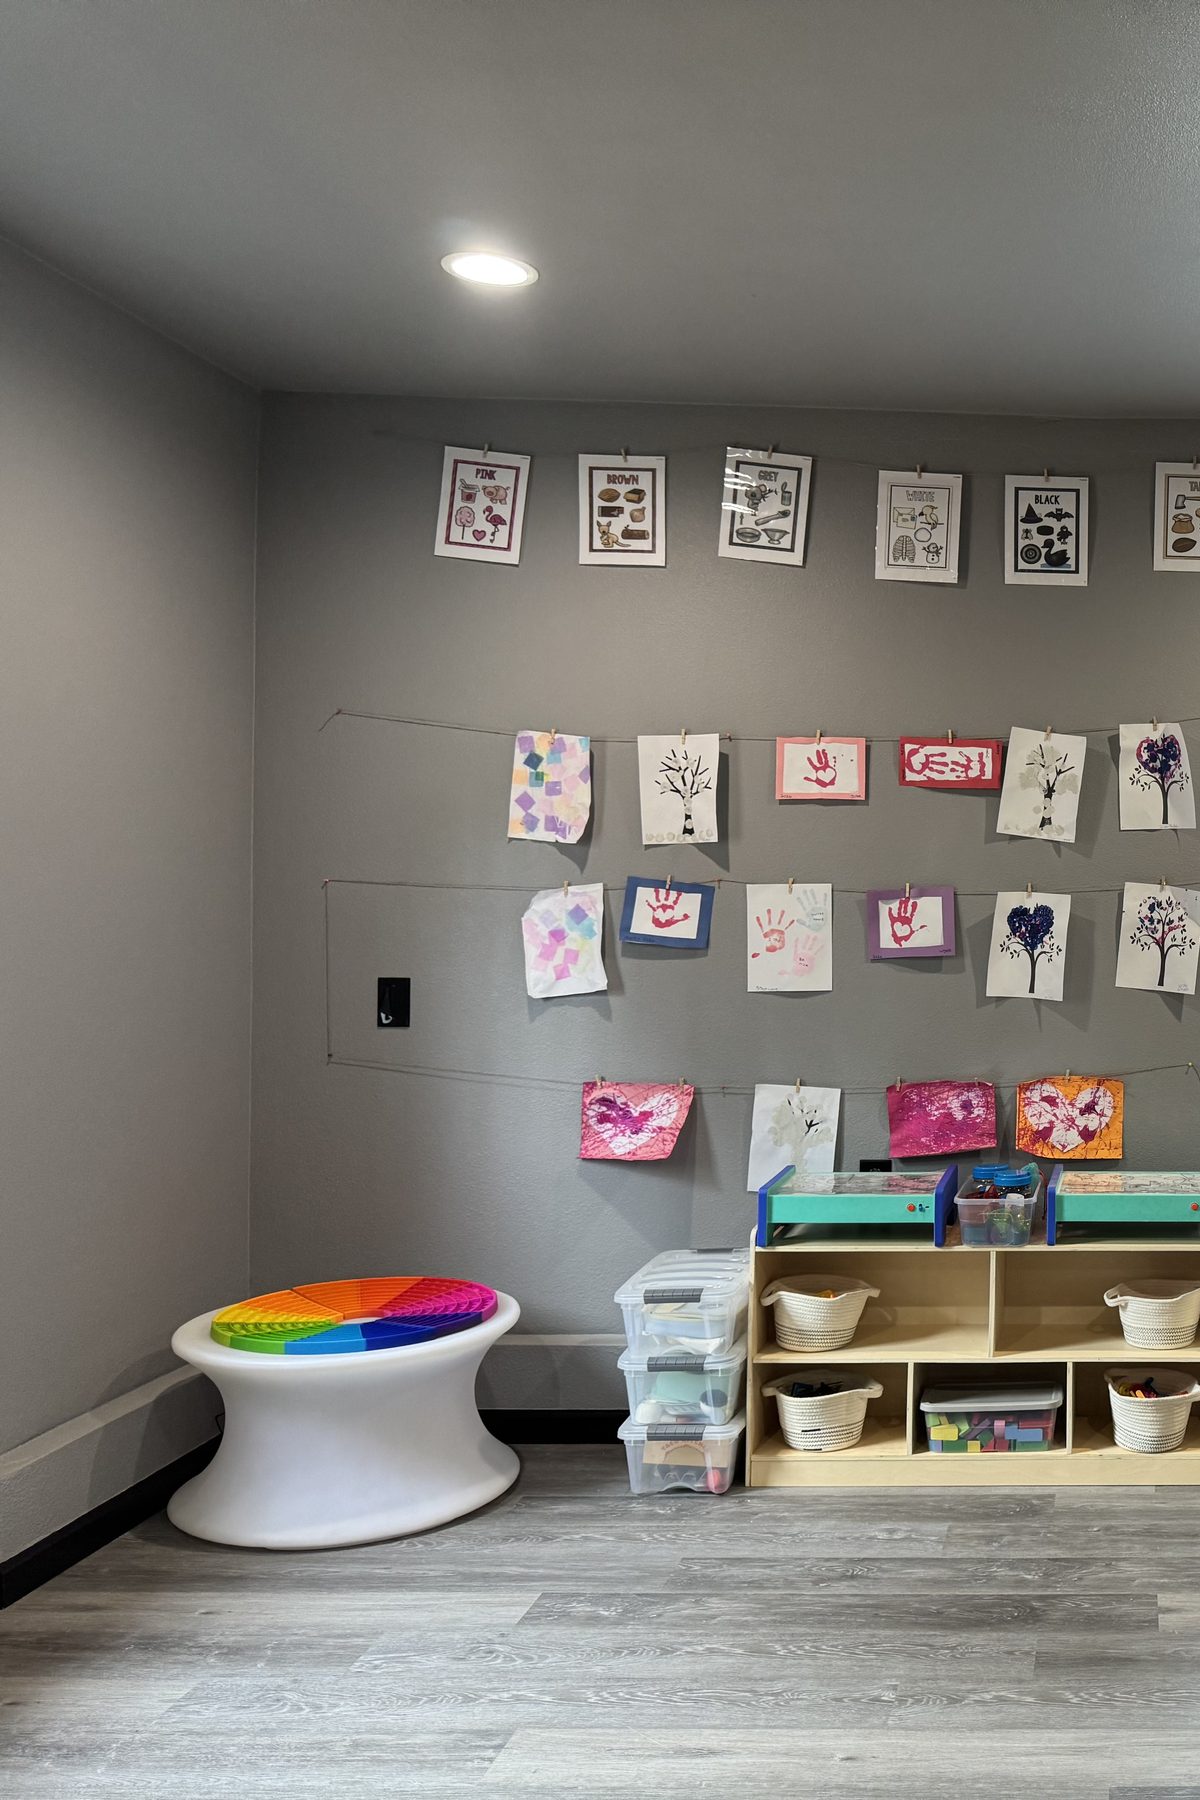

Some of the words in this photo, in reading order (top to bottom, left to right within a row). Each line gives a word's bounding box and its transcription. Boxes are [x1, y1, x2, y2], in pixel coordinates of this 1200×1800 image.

[475, 468, 496, 481] PINK
[606, 474, 640, 485] BROWN
[758, 470, 779, 482] GREY
[906, 490, 935, 503] WHITE
[1034, 495, 1060, 506] BLACK
